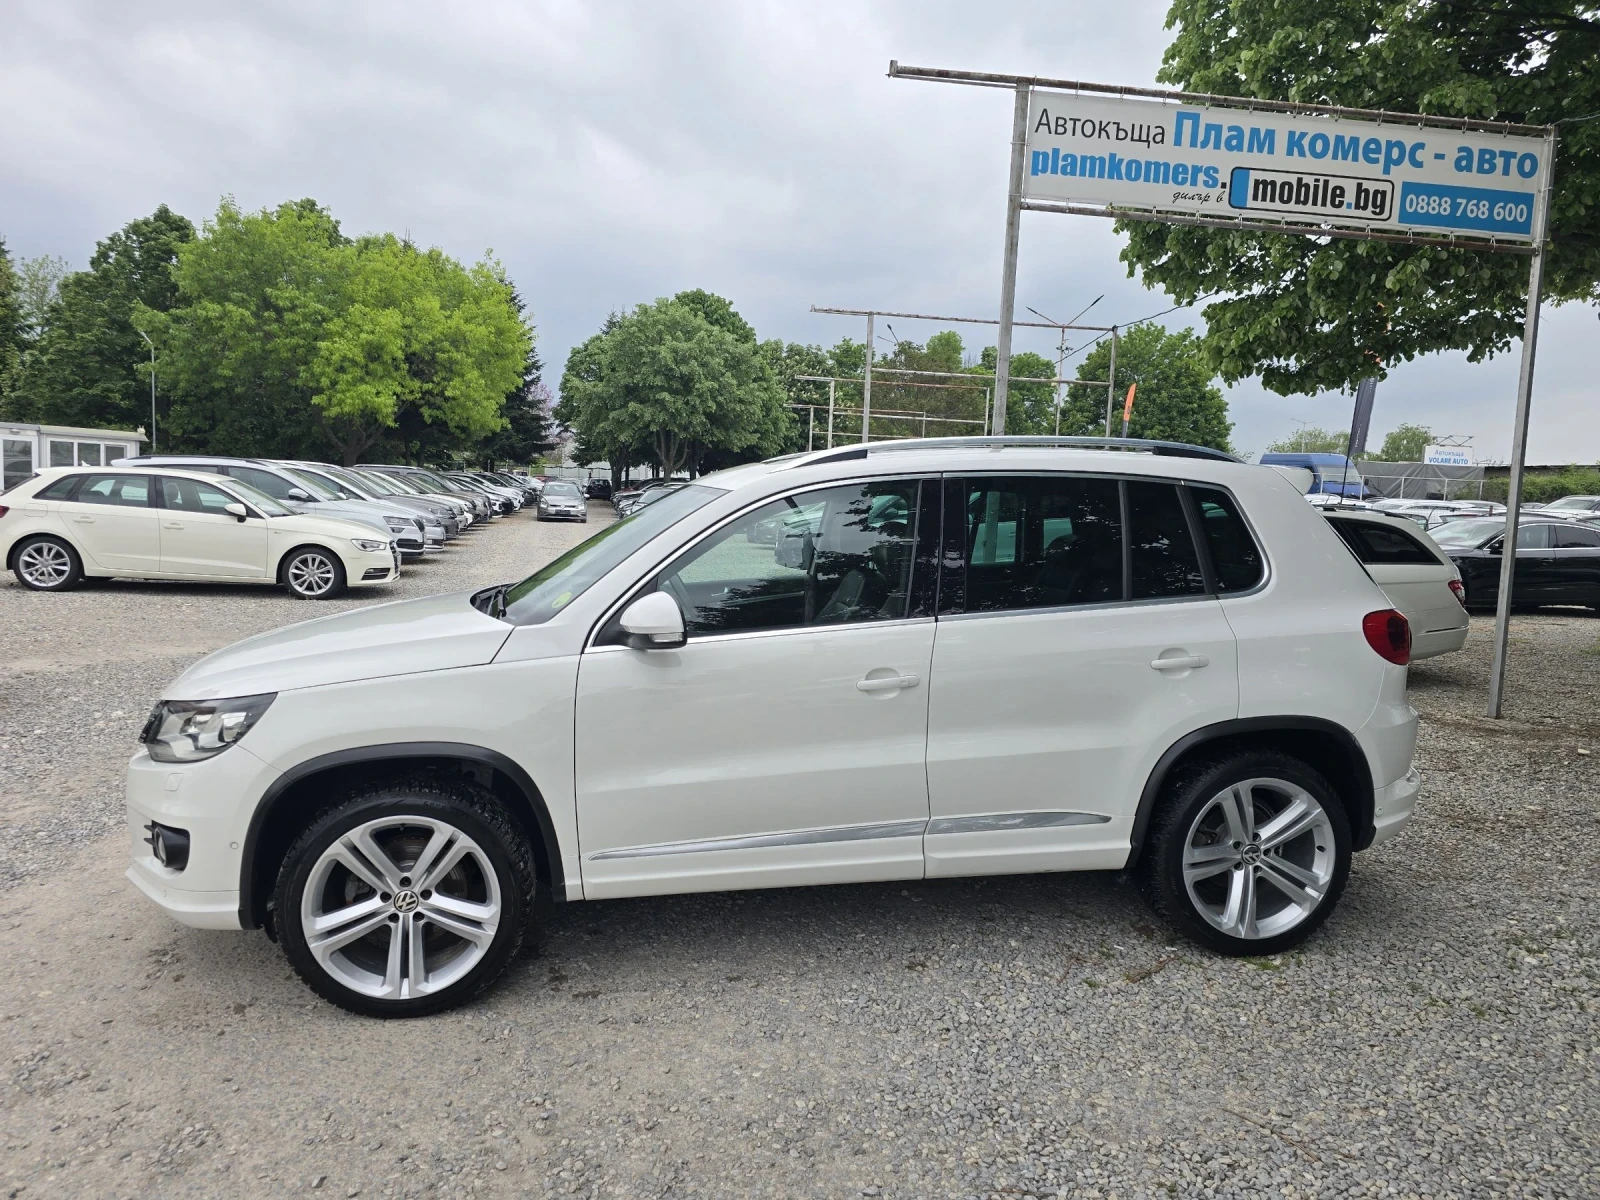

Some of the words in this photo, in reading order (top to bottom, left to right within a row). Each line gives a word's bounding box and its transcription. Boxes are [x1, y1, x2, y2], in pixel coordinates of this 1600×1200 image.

[1034, 108, 1166, 148] Автокъща
[1173, 111, 1276, 155] Плам
[1285, 130, 1426, 175] комерс
[1454, 145, 1539, 179] авто
[1252, 175, 1387, 216] mobile.bg
[1405, 194, 1450, 216] 0888
[1456, 198, 1489, 219] 768
[1493, 202, 1528, 222] 600
